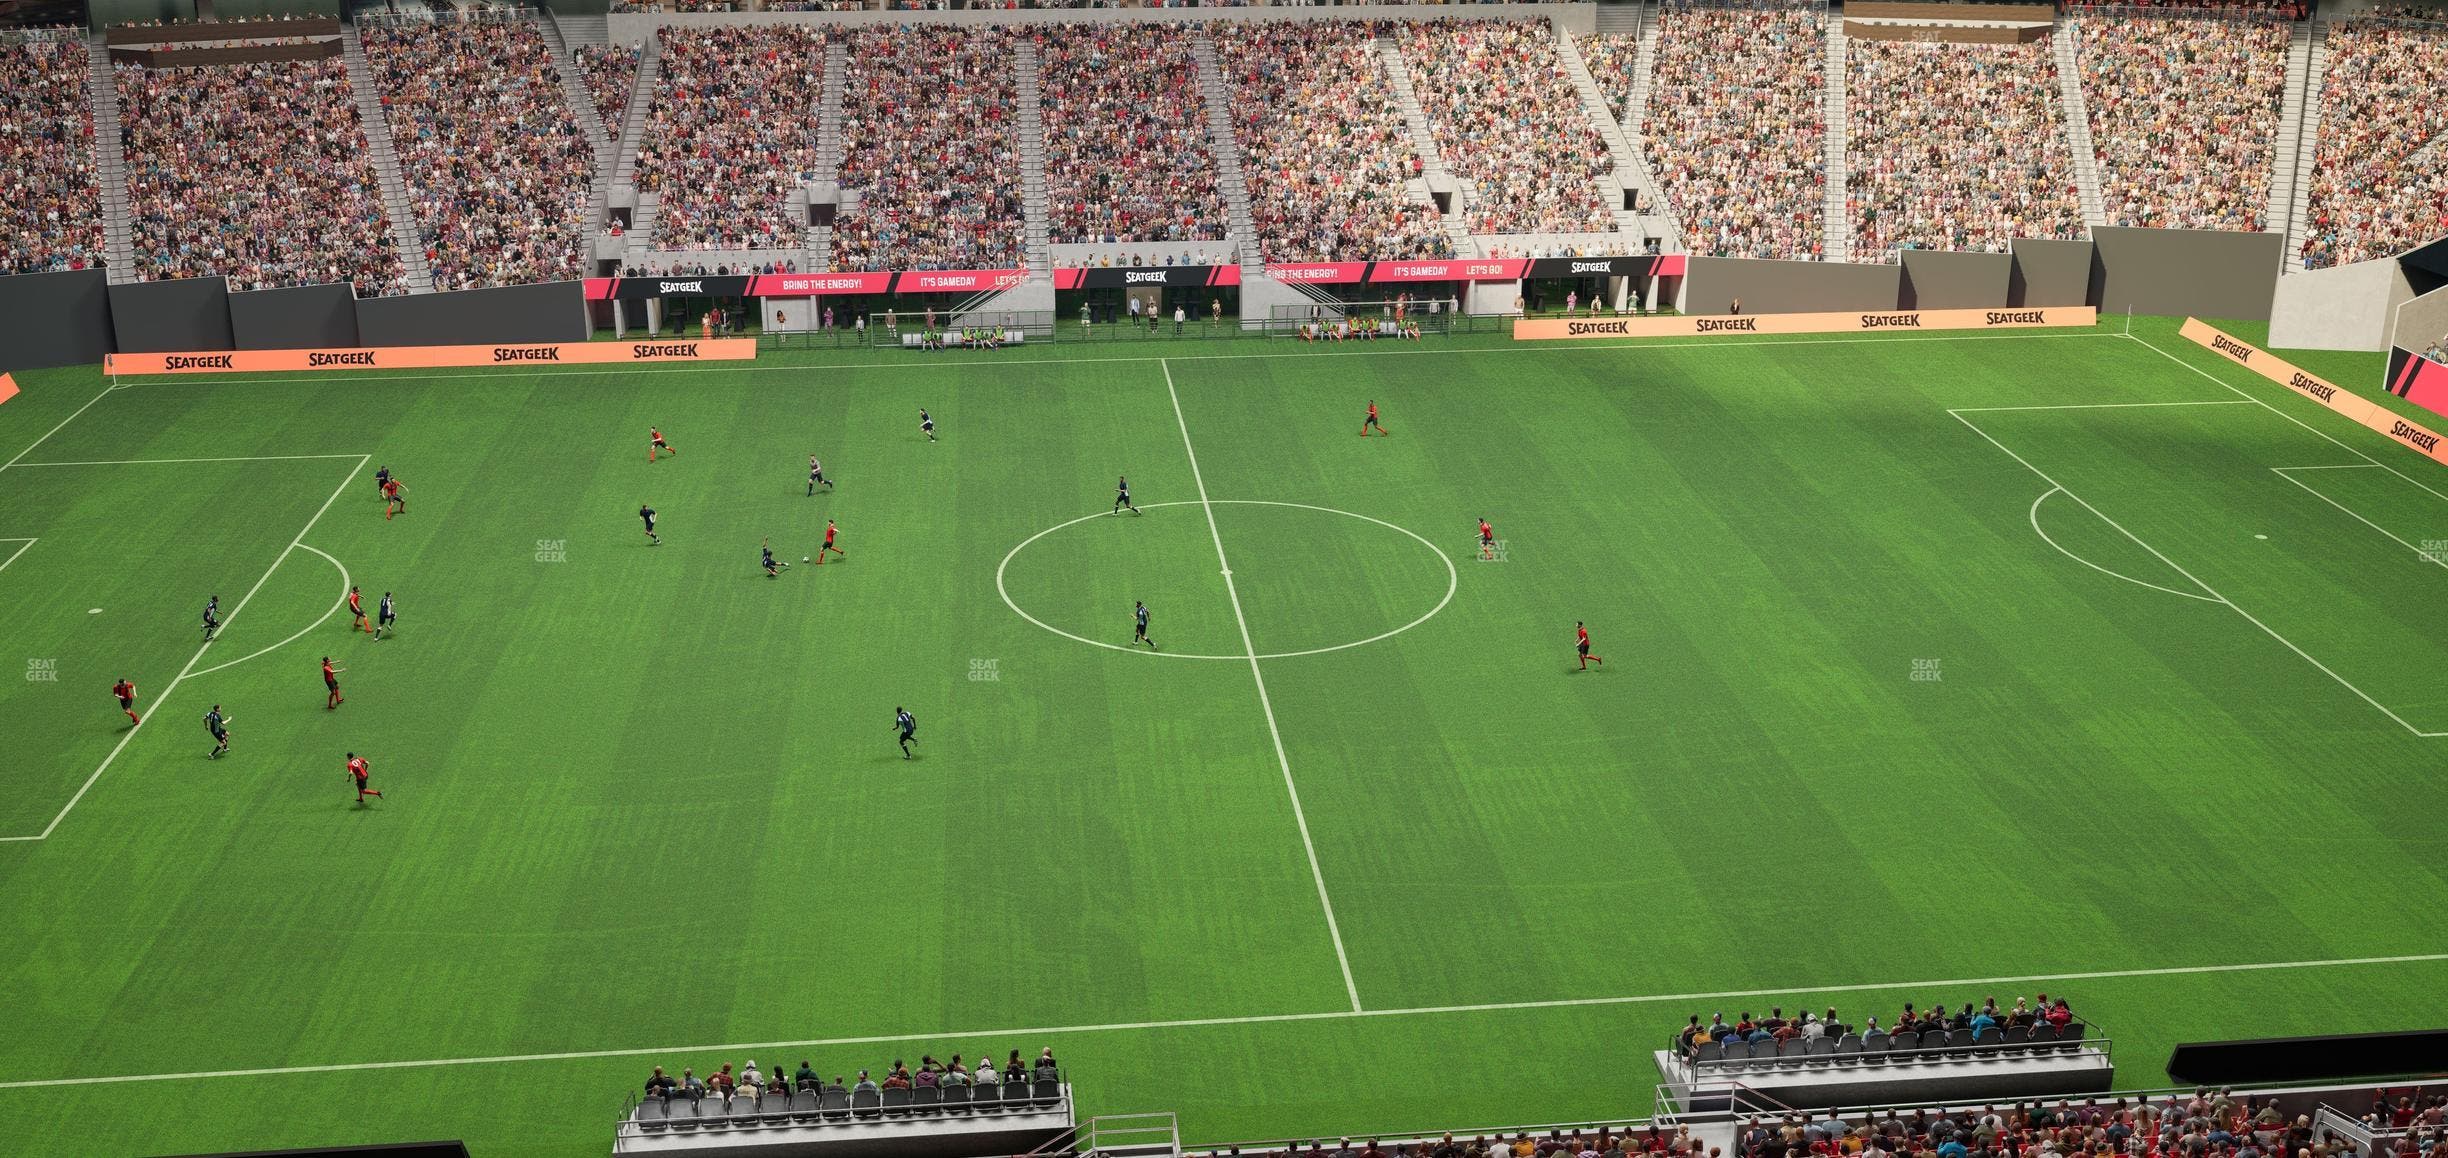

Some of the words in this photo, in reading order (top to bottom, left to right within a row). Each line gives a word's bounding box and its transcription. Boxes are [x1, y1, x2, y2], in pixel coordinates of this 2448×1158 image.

[1288, 269, 1303, 278] THE
[1304, 268, 1338, 278] ENERGY!
[1394, 267, 1409, 276] IT'S
[1410, 266, 1448, 276] GAMEDAY
[1466, 265, 1487, 275] LET'S
[1489, 265, 1503, 275] GO!
[1571, 261, 1611, 273] SEATGEEK
[920, 277, 936, 287] IT'S
[937, 276, 976, 287] GAMEDAY
[1126, 270, 1167, 283] SEATGEEK
[660, 280, 703, 293] SEATGEEK
[783, 280, 808, 290] BRING
[810, 280, 825, 289] THE
[827, 279, 862, 289] ENERGY!
[1861, 313, 1920, 328] SEATGEEK
[1986, 310, 2045, 325] SEATGEEK
[1568, 321, 1629, 335] SEATGEEK
[1696, 318, 1756, 332] SEATGEEK
[493, 346, 559, 362] SEATGEEK
[633, 343, 698, 358] SEATGEEK
[2211, 334, 2253, 363] SEATGEEK
[165, 354, 233, 370] SEATGEEK
[309, 351, 376, 367] SEATGEEK
[2290, 372, 2337, 403] SEATGEEK
[2390, 420, 2440, 453] SEATGEEK
